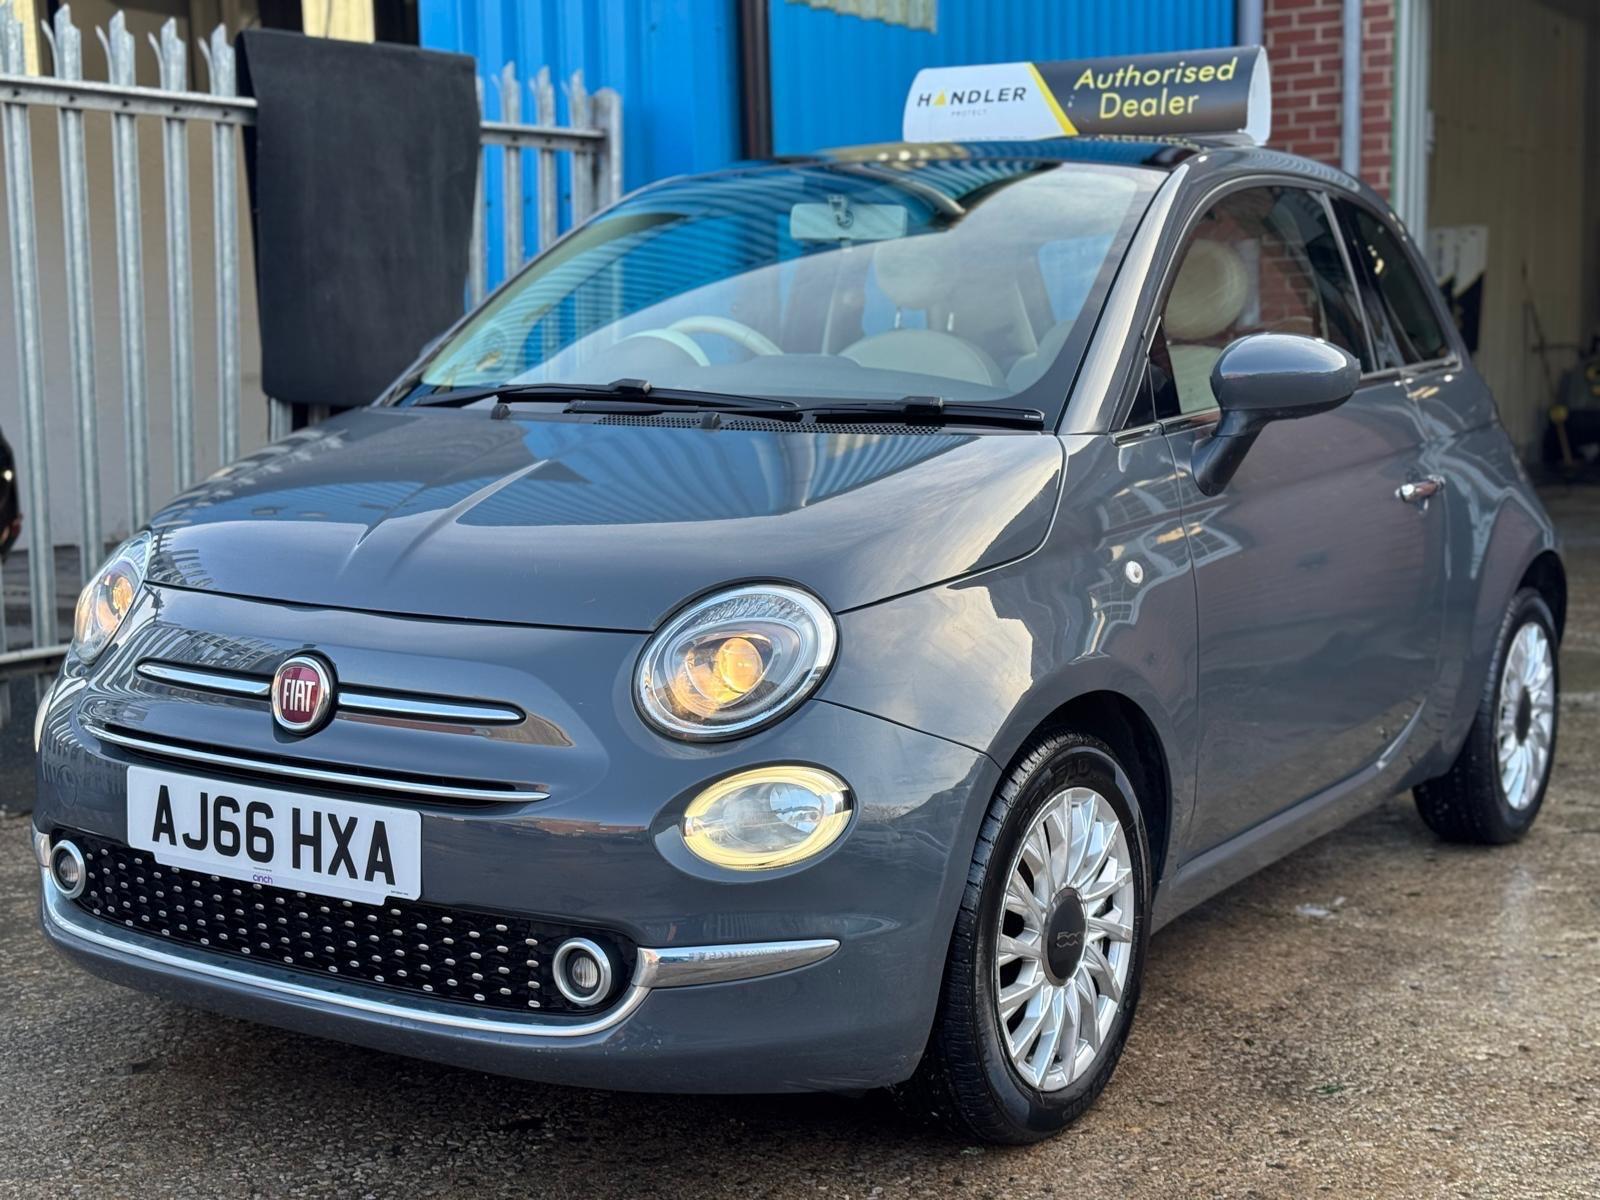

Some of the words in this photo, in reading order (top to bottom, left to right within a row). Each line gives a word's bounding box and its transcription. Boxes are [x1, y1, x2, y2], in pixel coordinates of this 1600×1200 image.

[1073, 56, 1239, 91] Authorised
[1100, 87, 1199, 119] Dealer
[282, 678, 316, 713] FIAT
[152, 785, 275, 864] AJ66
[292, 807, 396, 887] HXA
[252, 873, 273, 885] cinch
